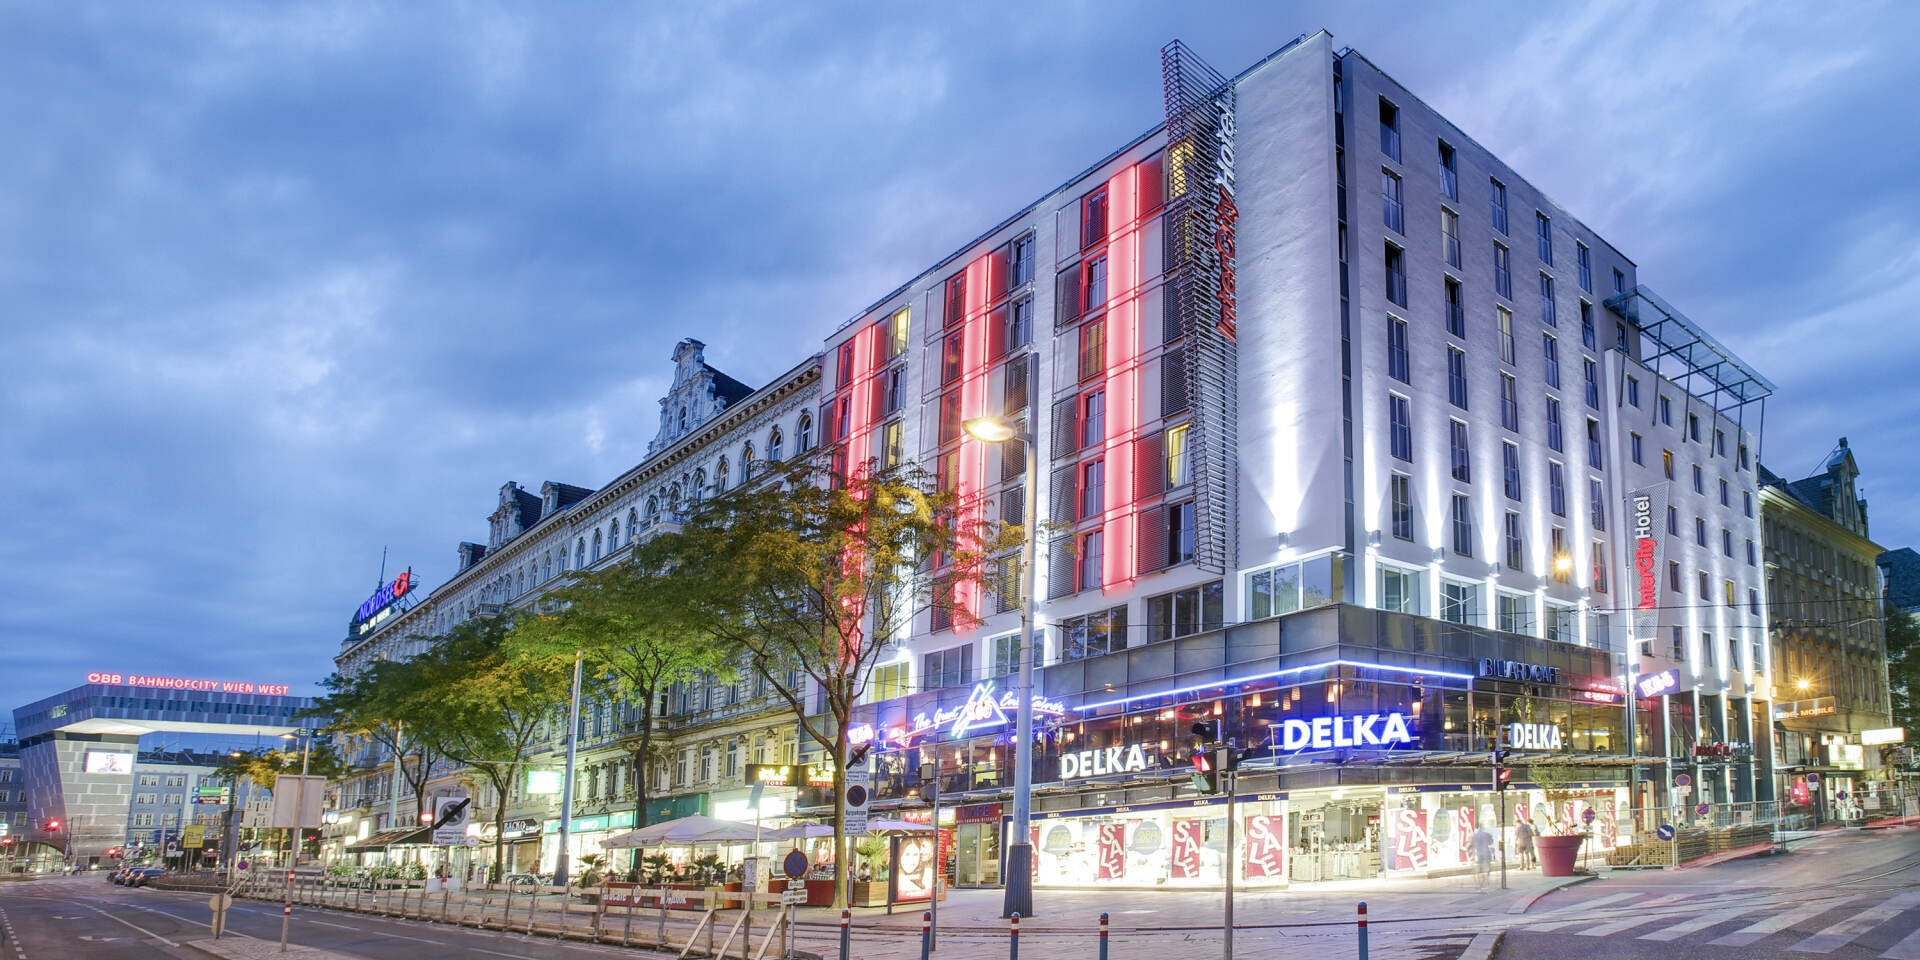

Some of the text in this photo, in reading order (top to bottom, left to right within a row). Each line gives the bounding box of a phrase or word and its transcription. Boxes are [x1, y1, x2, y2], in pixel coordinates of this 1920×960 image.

[1633, 495, 1658, 611] InterCityHotel
[358, 580, 397, 622] NORDSEE
[87, 672, 289, 695] ÖBB BAHNHOFCITY WIEN WEST
[913, 712, 932, 731] The
[1283, 712, 1411, 751] DELKA
[1511, 722, 1562, 750] DELKA
[1060, 743, 1147, 780] DELKA
[1194, 799, 1210, 807] DELKA
[1303, 813, 1321, 821] ara
[1100, 823, 1124, 879] SALE
[1173, 820, 1200, 878] SALE
[1248, 815, 1283, 877] SALE
[1397, 809, 1429, 871] SALE
